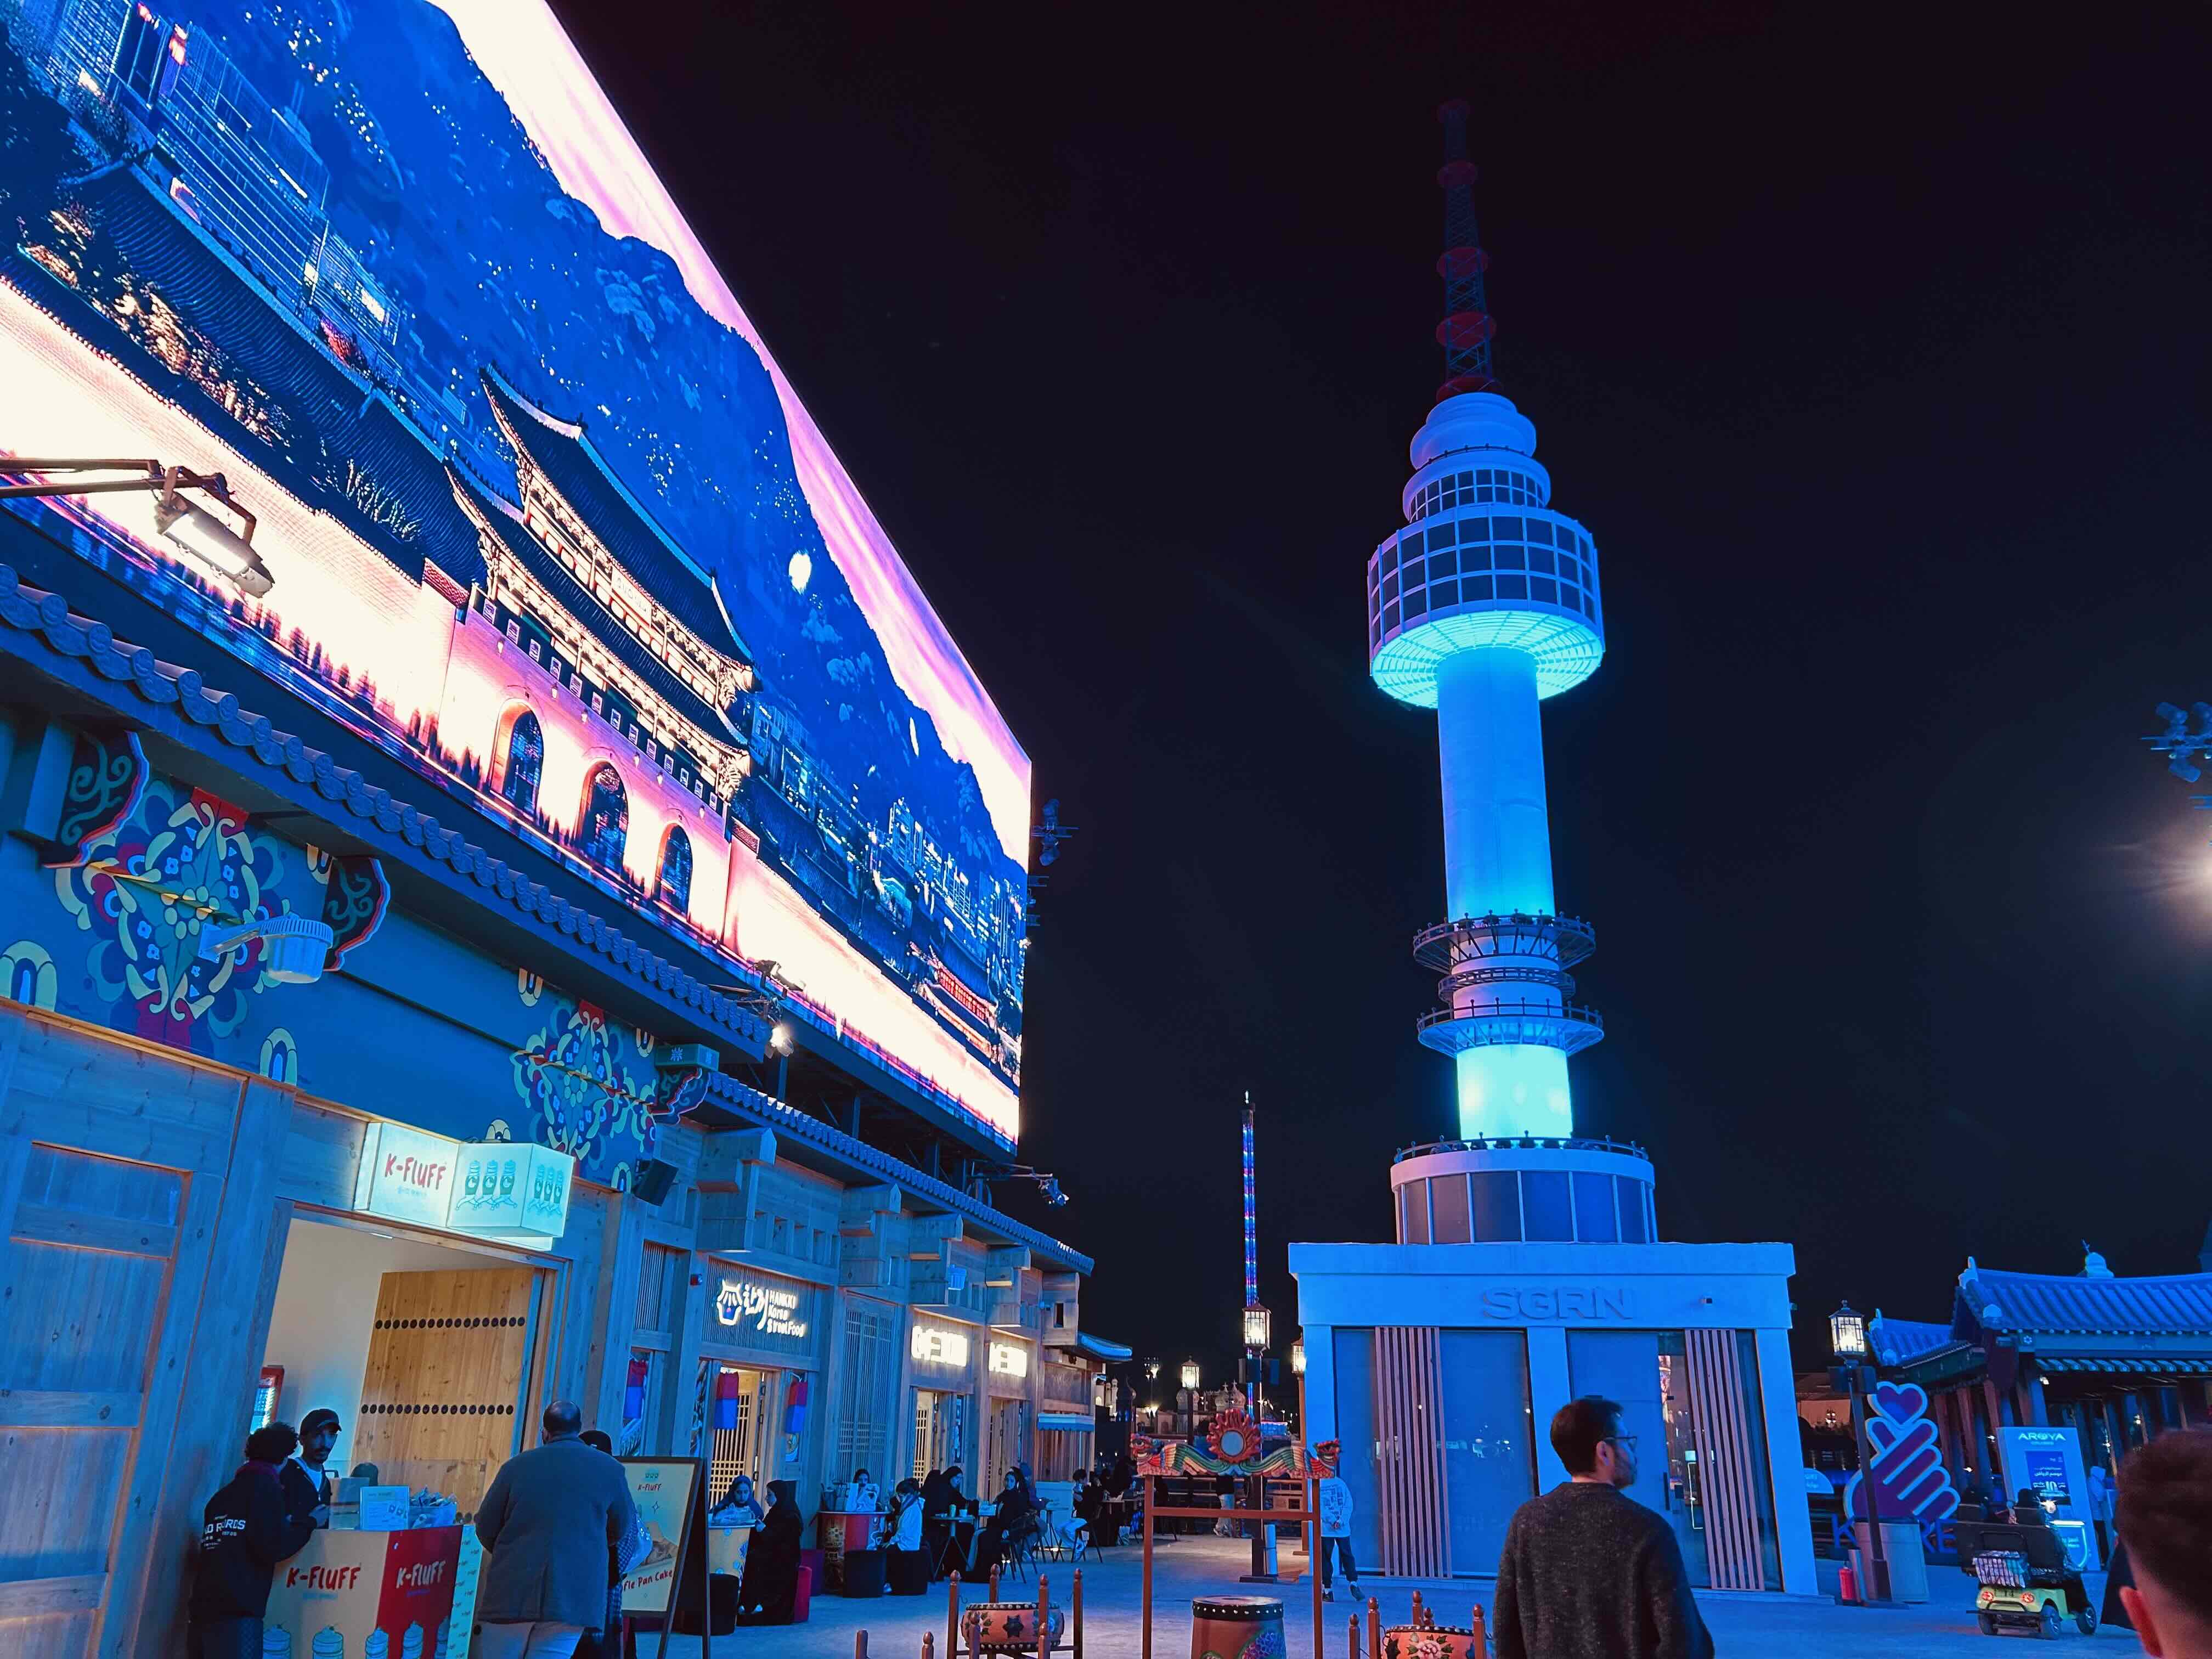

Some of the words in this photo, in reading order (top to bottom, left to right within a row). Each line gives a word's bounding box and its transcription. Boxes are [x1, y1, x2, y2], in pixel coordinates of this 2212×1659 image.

[1482, 1286, 1634, 1320] SGRN
[638, 1576, 653, 1588] Pan
[655, 1570, 673, 1581] Cake
